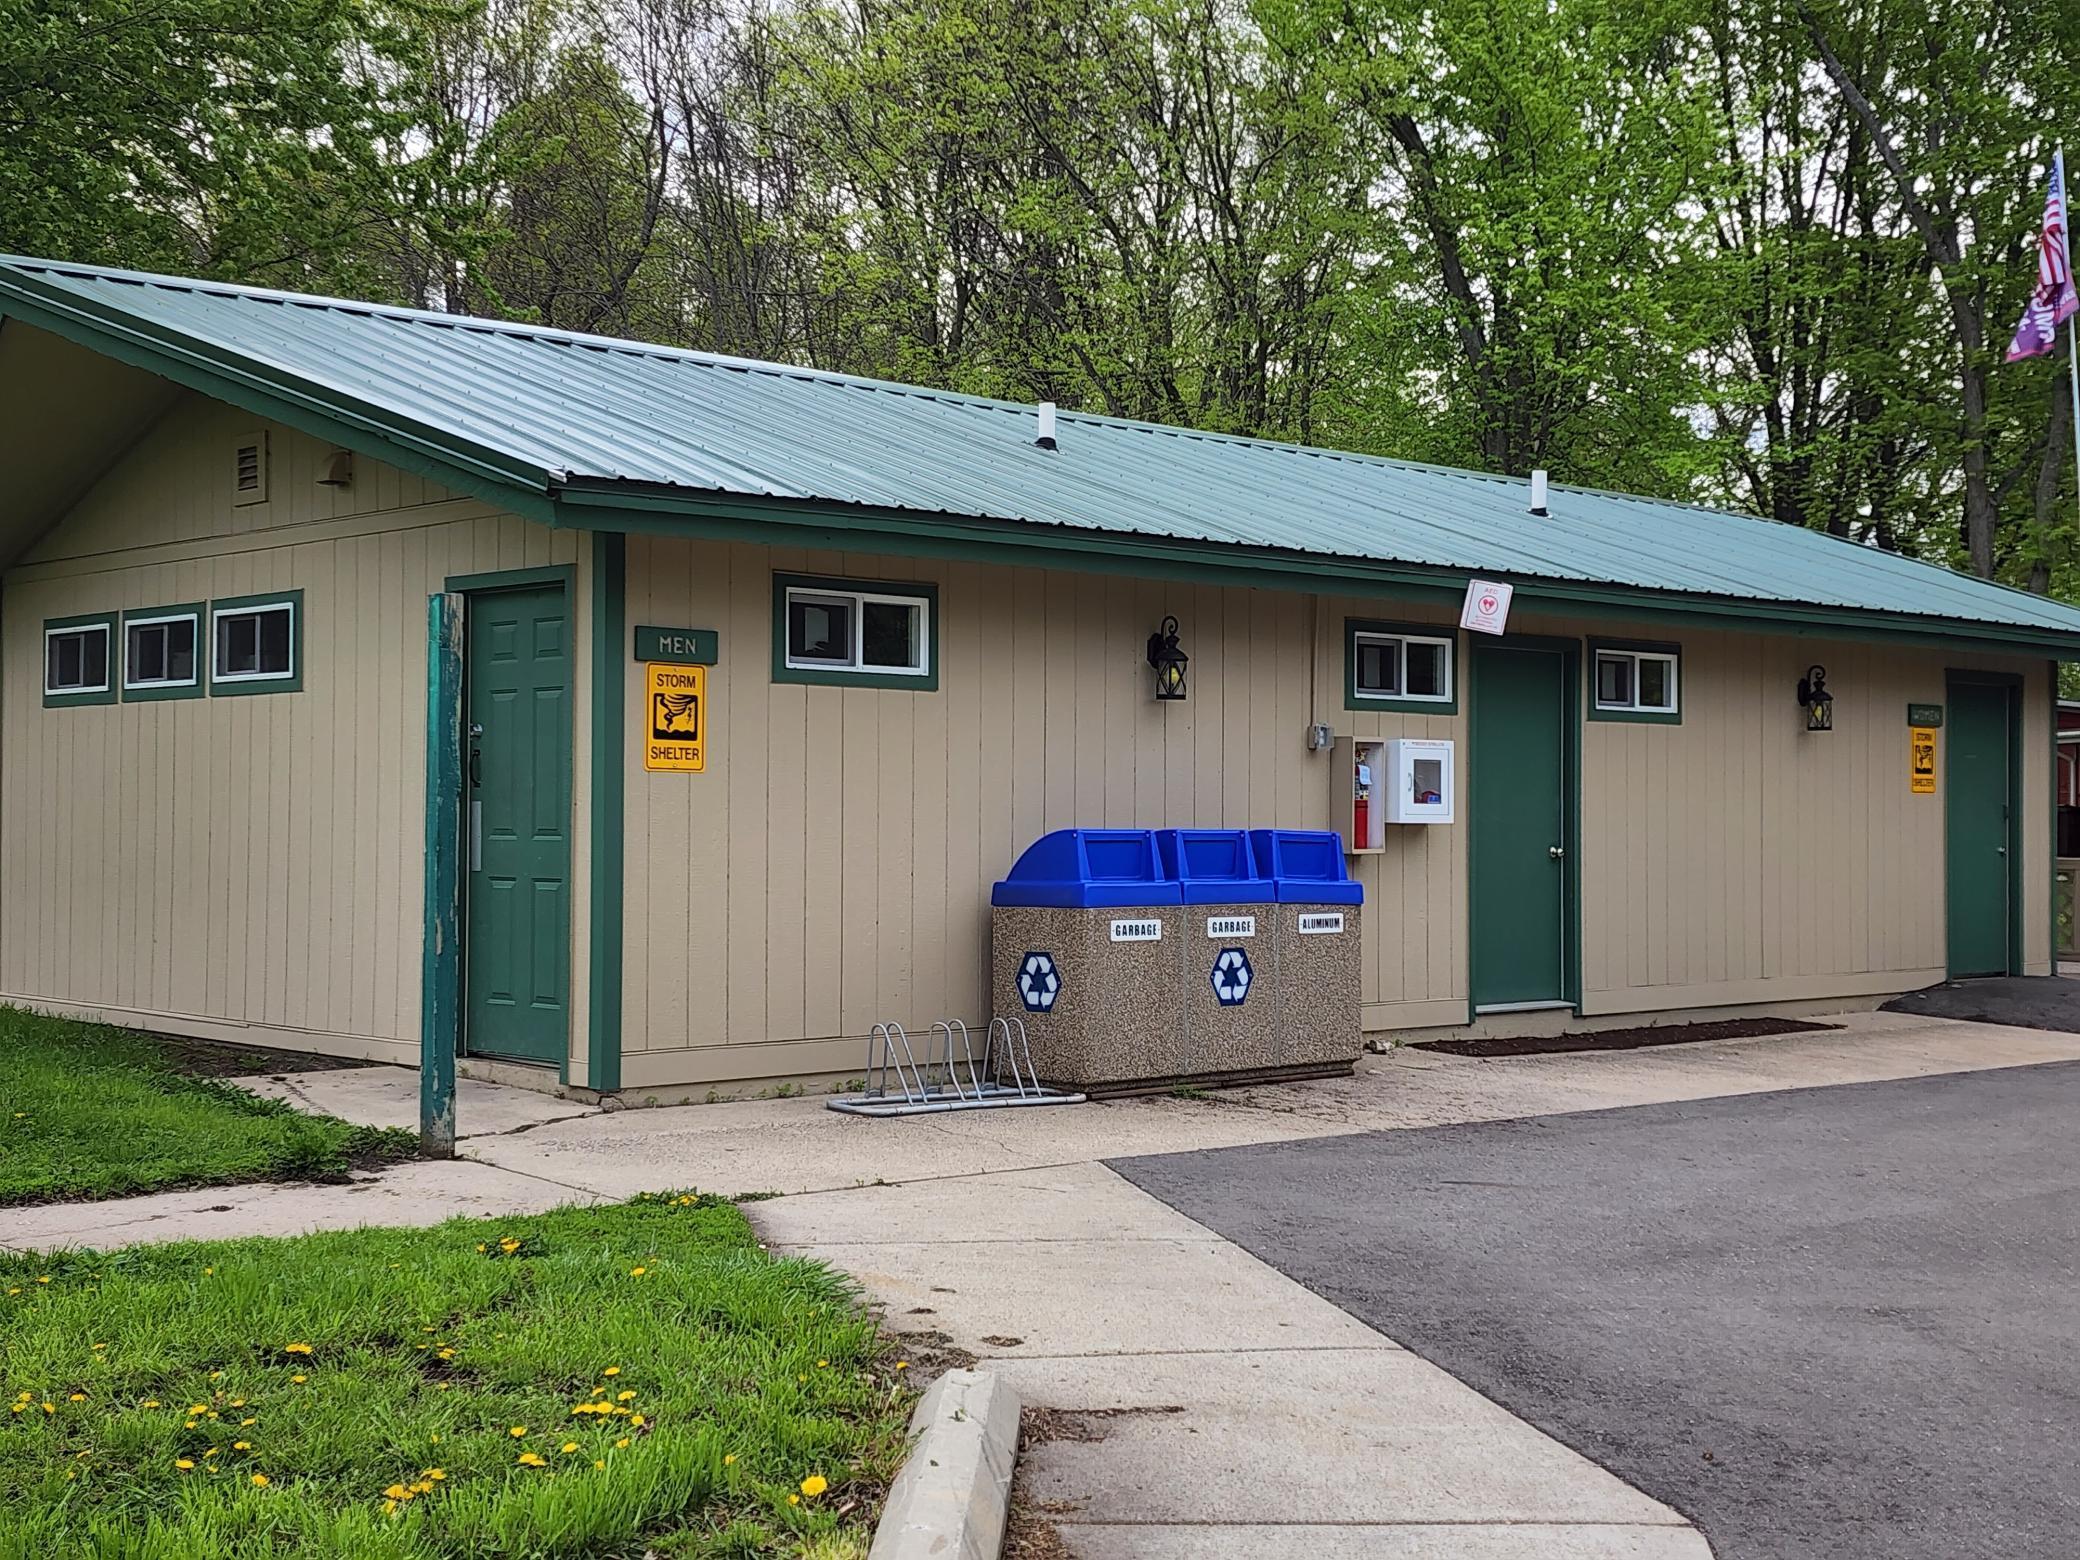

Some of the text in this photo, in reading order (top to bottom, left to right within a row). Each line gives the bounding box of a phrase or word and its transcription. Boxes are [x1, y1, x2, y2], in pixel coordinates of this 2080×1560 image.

[659, 636, 696, 654] MEN
[656, 673, 696, 688] STORM
[650, 746, 700, 761] SHELTER
[1115, 924, 1157, 937] GARBAGE
[1211, 920, 1251, 933] GARBAGE
[1302, 917, 1341, 930] ALUMINUM
